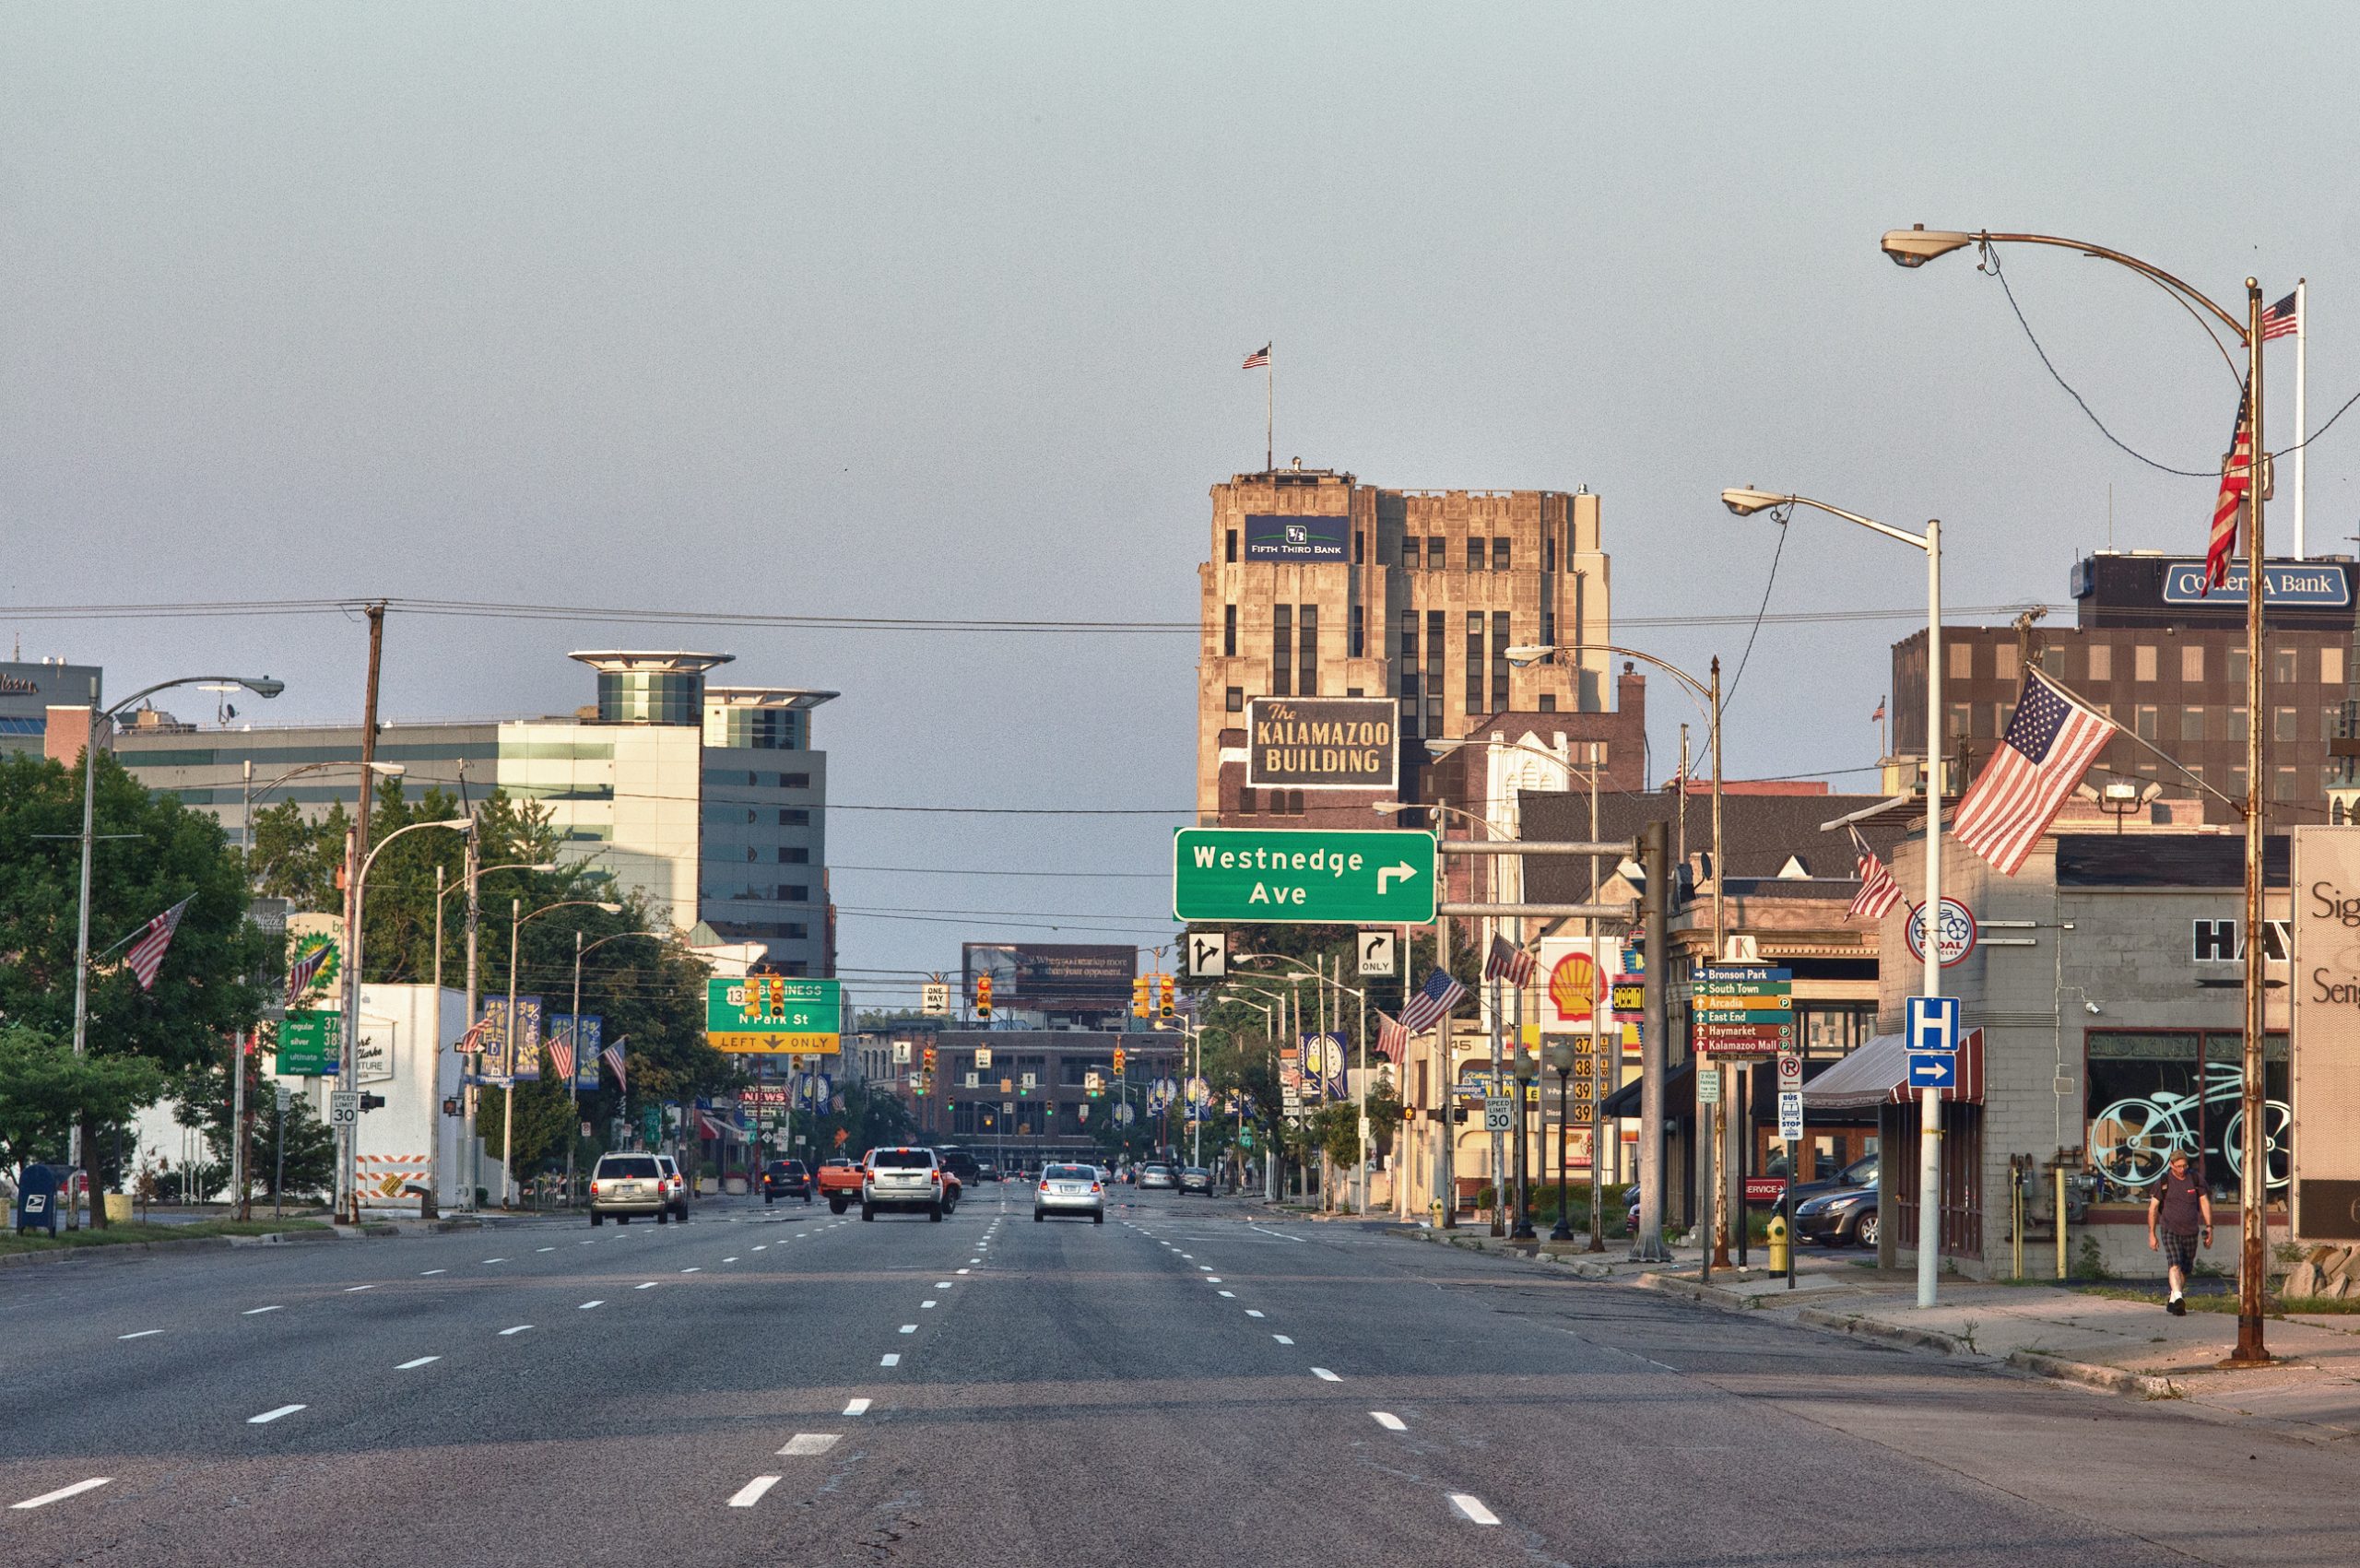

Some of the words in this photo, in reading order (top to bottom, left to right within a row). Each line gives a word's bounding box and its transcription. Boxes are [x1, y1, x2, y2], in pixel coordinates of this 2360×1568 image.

[1252, 545, 1278, 553] FIFTH
[1281, 545, 1311, 554] THIRD
[1315, 546, 1341, 554] BANK
[2179, 573, 2276, 595] CoerA
[2281, 574, 2333, 593] Bank
[1268, 703, 1297, 720] The
[1257, 722, 1389, 746] KALAMAZOO
[1267, 749, 1380, 773] BUILDING
[1194, 846, 1363, 878] Westnedge
[1248, 882, 1306, 904] Ave
[1919, 941, 1963, 949] PDAL
[2193, 919, 2291, 961] HA
[1363, 962, 1389, 971] ONLY
[1709, 970, 1745, 979] Bronson
[1747, 970, 1767, 979] Park
[729, 991, 743, 1001] 13
[759, 985, 822, 996] BUINESS
[1709, 984, 1735, 993] South
[1737, 984, 1759, 993] Town
[2313, 968, 2360, 1008] Seri
[1709, 998, 1743, 1008] Arcadia
[739, 1015, 748, 1024] N
[754, 1015, 786, 1024] Park
[793, 1015, 808, 1024] St
[1709, 1012, 1728, 1021] East
[1729, 1011, 1746, 1021] End
[324, 1017, 340, 1030] 37
[1914, 1000, 1952, 1047] H
[1709, 1026, 1756, 1037] Haymarket
[324, 1032, 340, 1046] 38
[721, 1038, 756, 1047] LEFT
[791, 1038, 828, 1047] ONLY
[1709, 1040, 1756, 1050] Kalamazoo
[1758, 1040, 1777, 1050] Mall
[290, 1052, 317, 1061] ultimate
[334, 1109, 354, 1122] 30
[1489, 1114, 1509, 1126] 30
[1746, 1185, 1777, 1194] ERVICE
